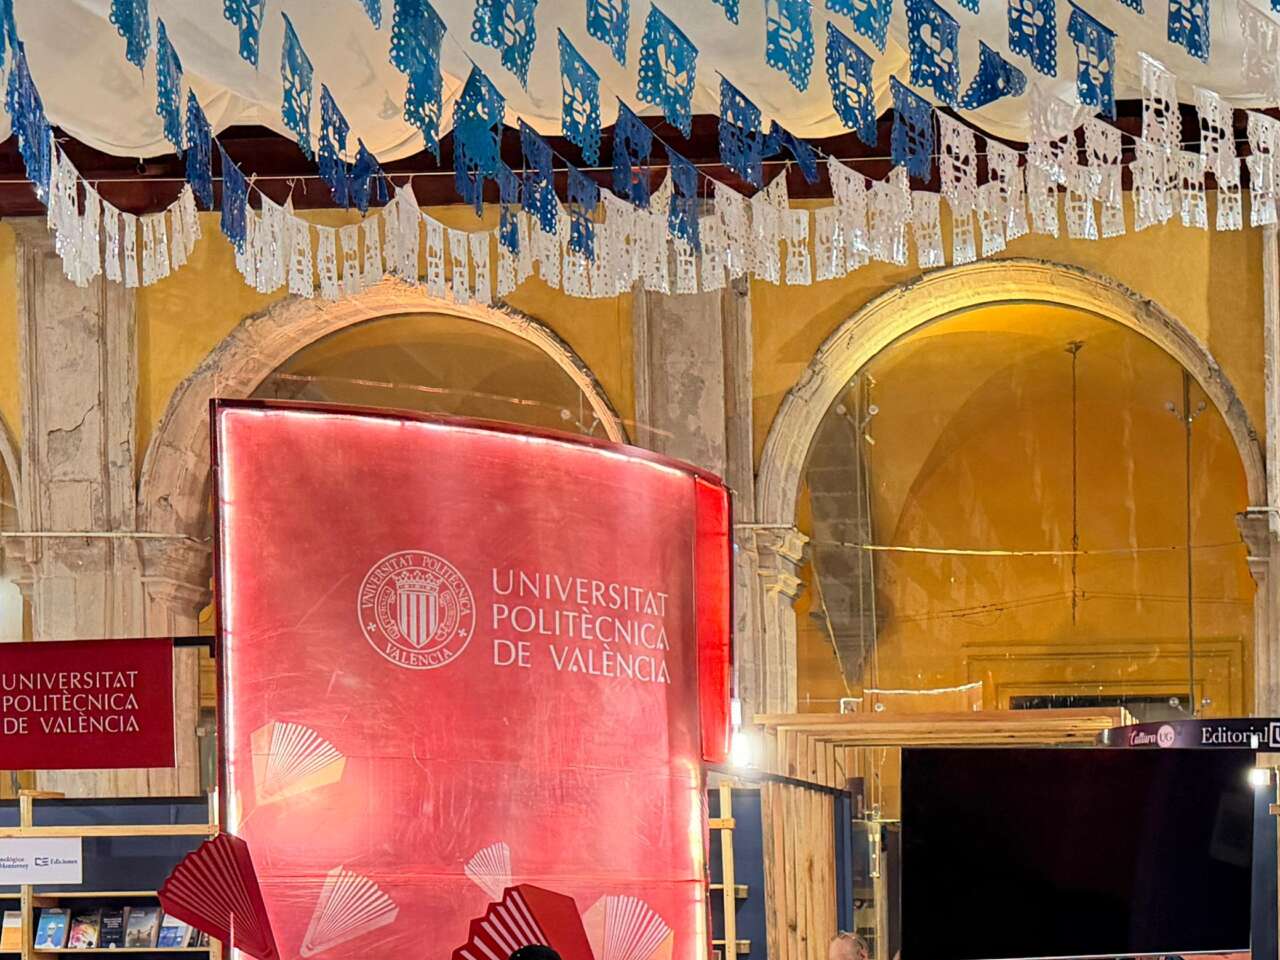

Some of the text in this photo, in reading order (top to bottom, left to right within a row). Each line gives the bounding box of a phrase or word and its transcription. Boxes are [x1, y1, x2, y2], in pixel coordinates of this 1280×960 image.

[492, 567, 669, 617] UNIVERSITAT
[492, 603, 670, 651] POLITÈCNICA
[493, 639, 671, 685] DE VALÈNCIA
[2, 670, 139, 692] UNIVERSITAT
[2, 690, 140, 713] POLITÈCNICA
[3, 711, 140, 735] DE VALÈNCIA
